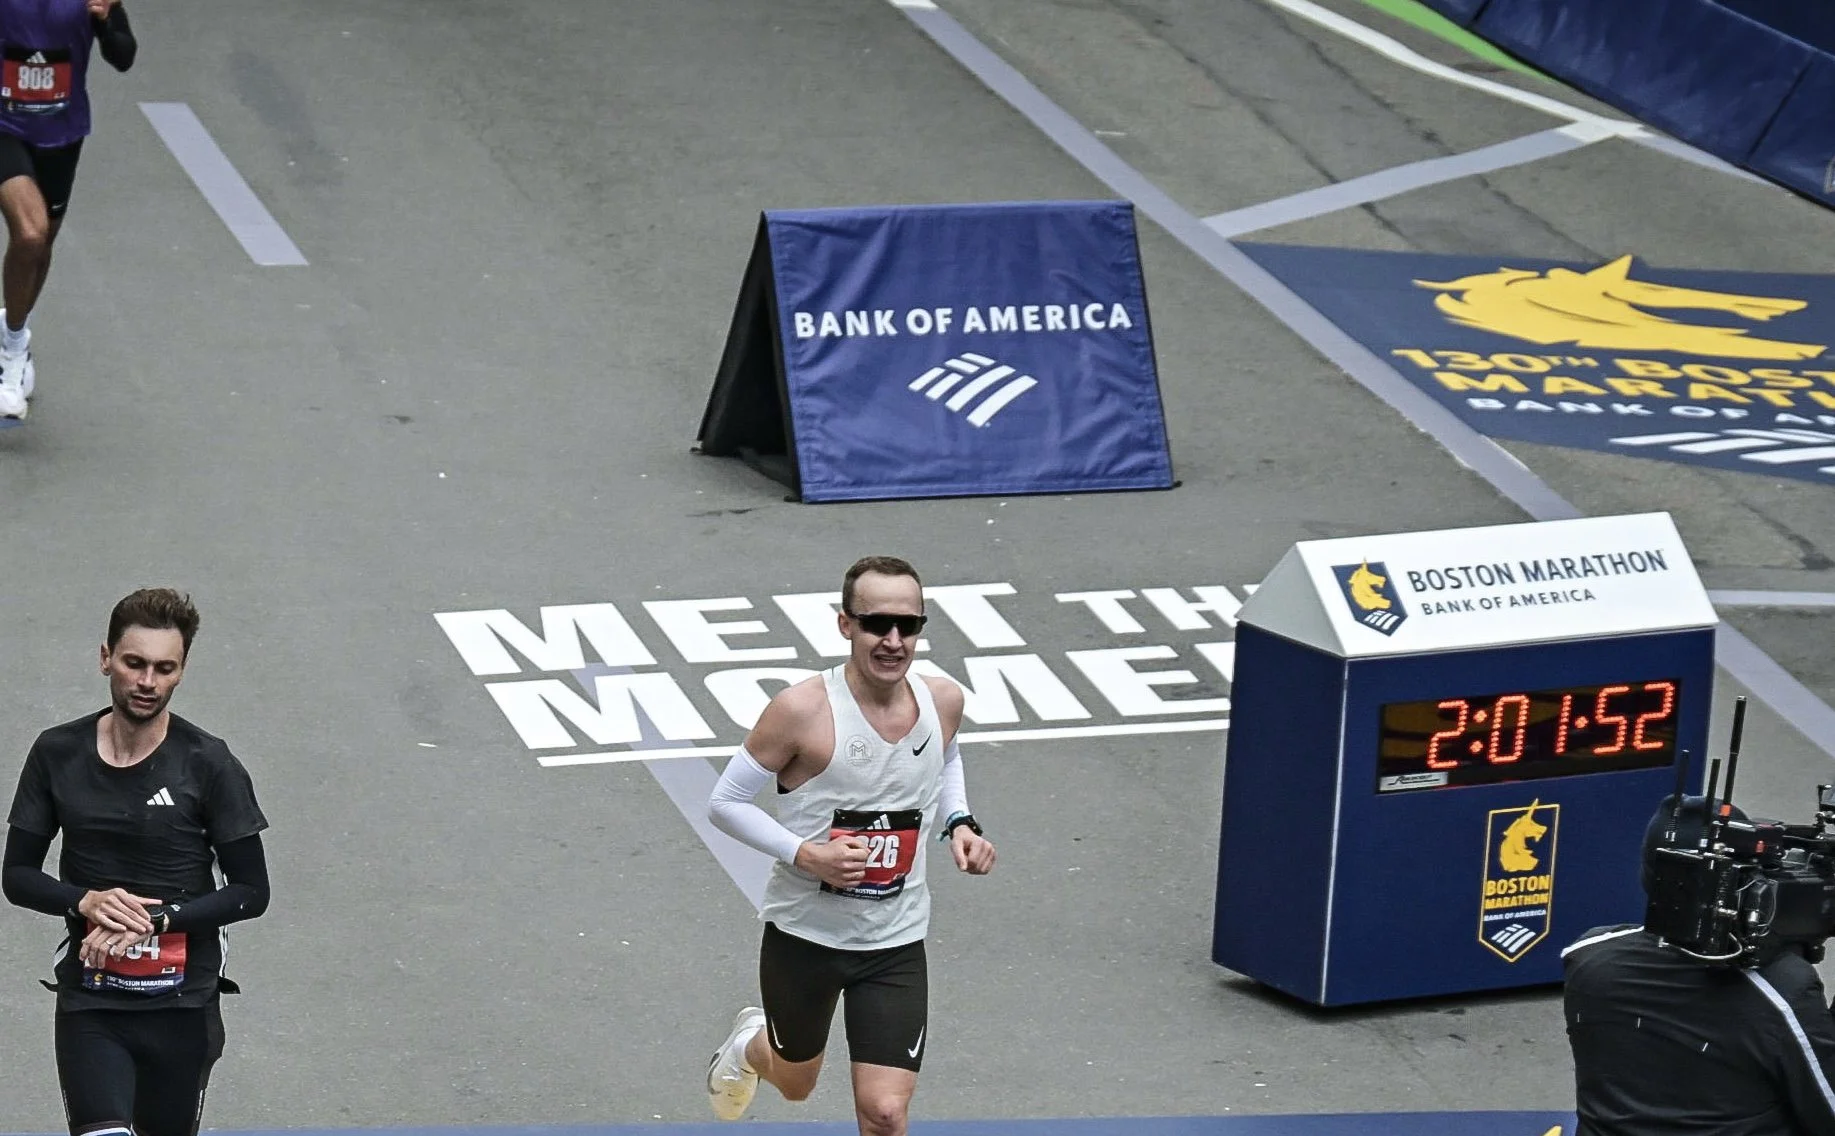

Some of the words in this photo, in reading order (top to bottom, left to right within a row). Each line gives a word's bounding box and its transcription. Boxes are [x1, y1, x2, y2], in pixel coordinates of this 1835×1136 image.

[794, 310, 898, 338] BANK
[906, 306, 952, 335] OF
[963, 302, 1132, 334] AMERICA
[1466, 397, 1655, 416] BANK
[1669, 405, 1749, 419] OF
[1407, 562, 1517, 592] BOSTON
[1519, 549, 1669, 583] MARATHON
[1054, 583, 1261, 634] TH
[1421, 599, 1476, 616] BANK
[1479, 595, 1504, 610] OF
[1509, 588, 1597, 607] AMERICA
[856, 835, 900, 868] 26
[1486, 874, 1551, 896] BOSTON
[1485, 893, 1549, 910] MARATHON
